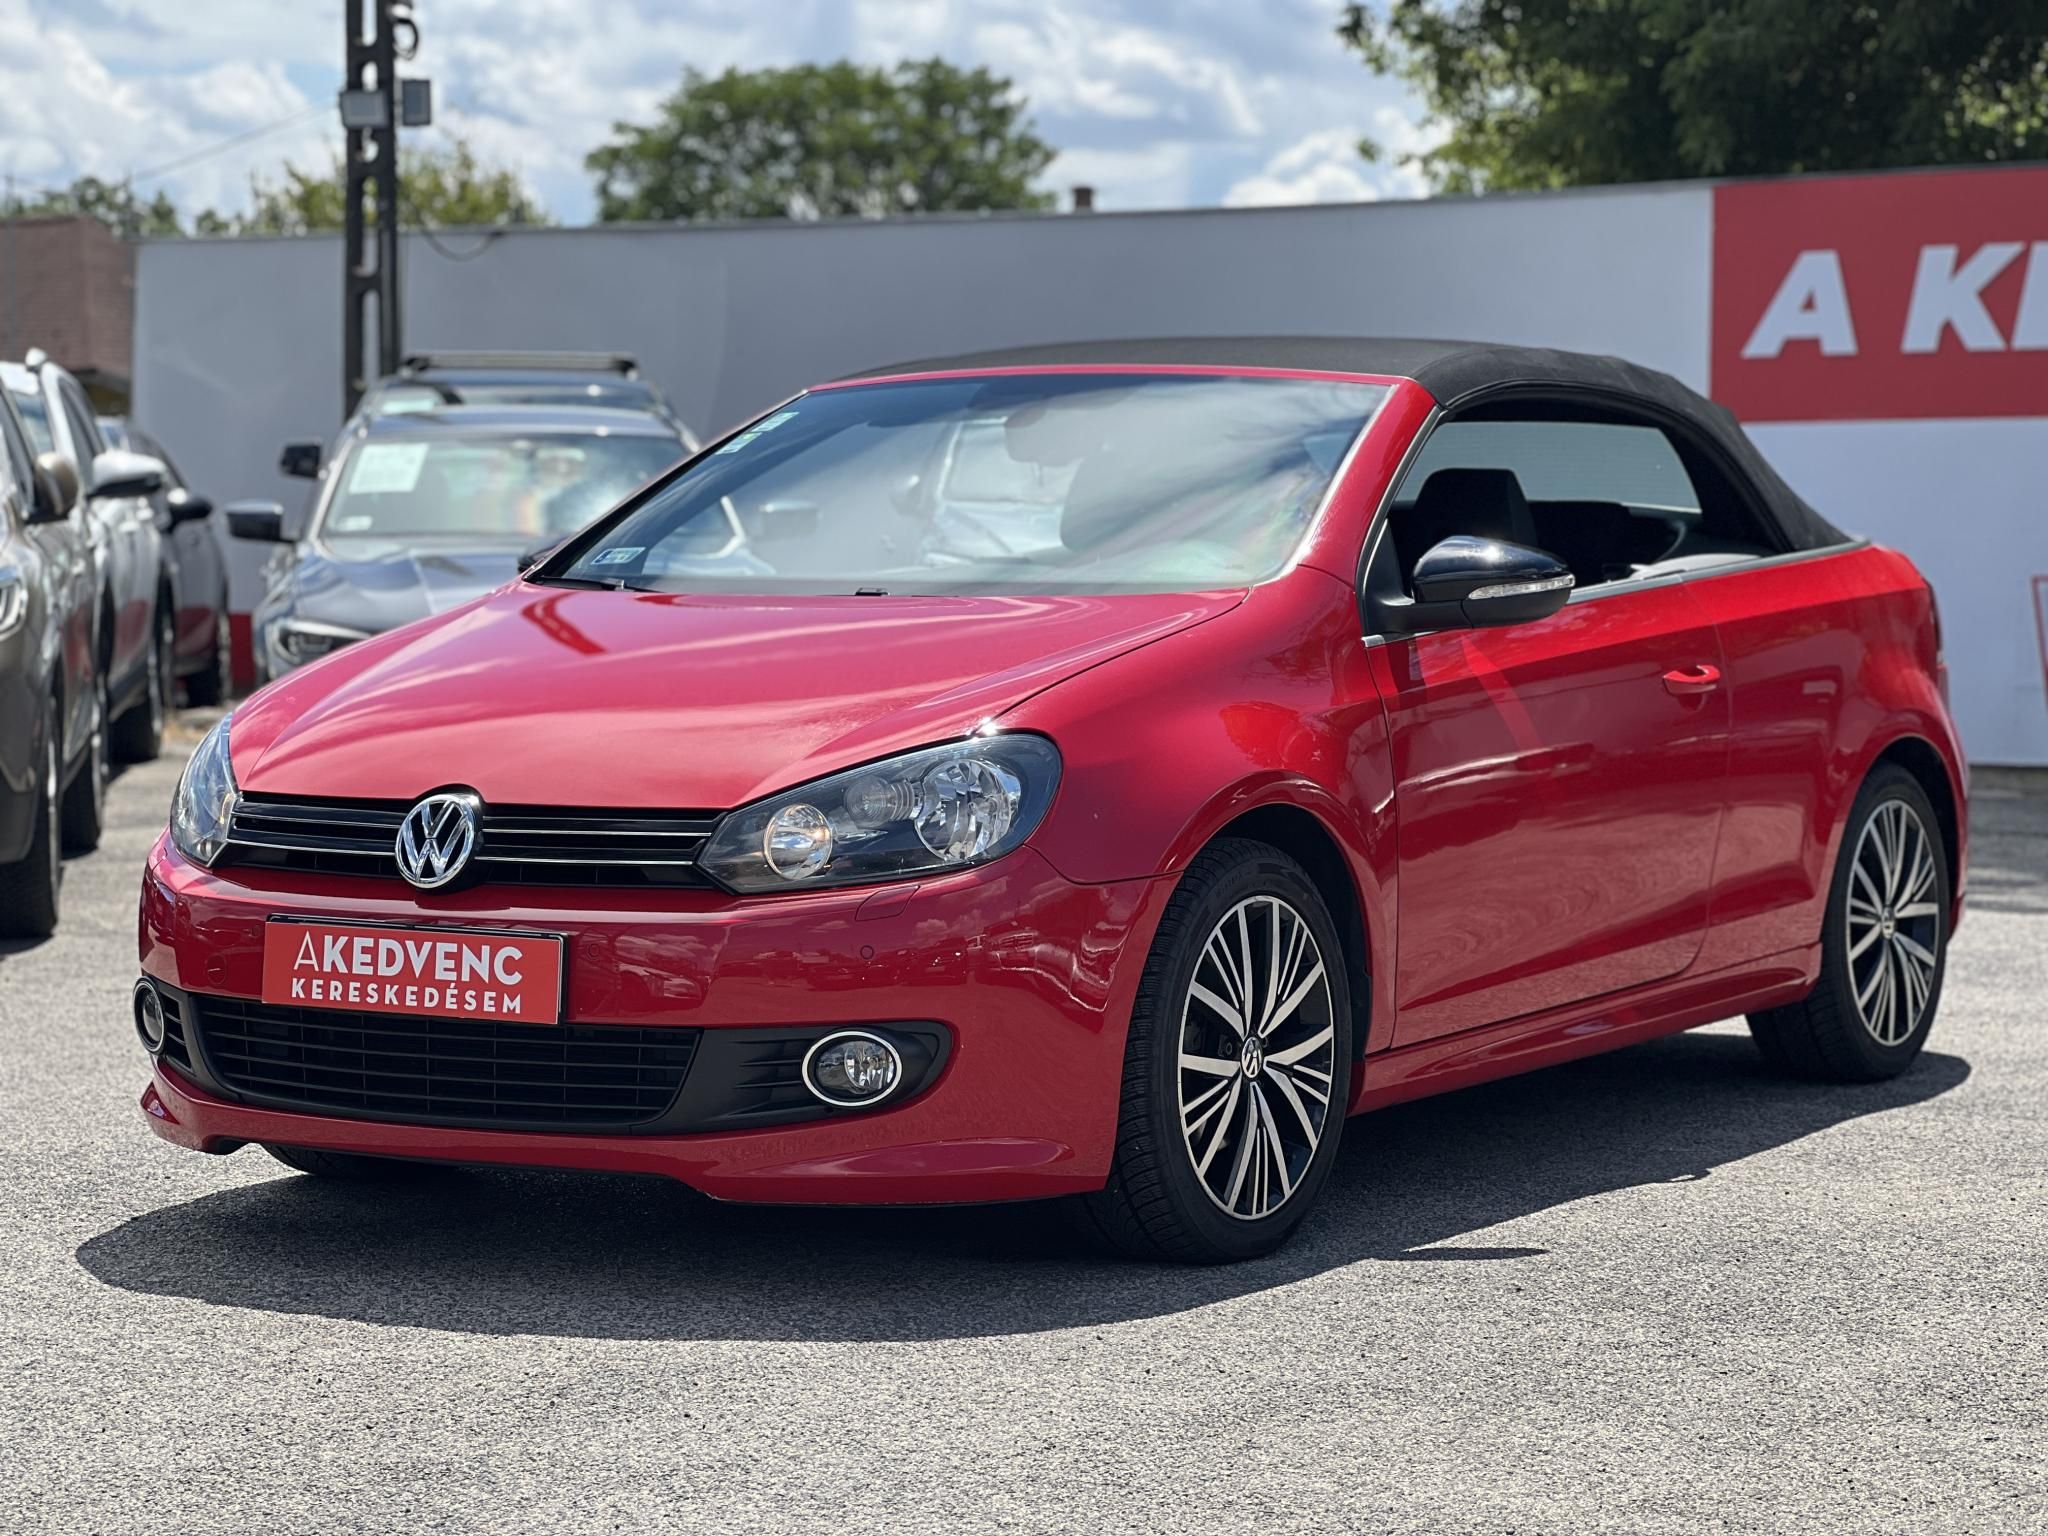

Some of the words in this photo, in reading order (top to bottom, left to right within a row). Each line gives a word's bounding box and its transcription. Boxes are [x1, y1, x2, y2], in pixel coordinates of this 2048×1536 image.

[1740, 249, 1859, 359] A
[397, 796, 472, 886] VW
[291, 977, 522, 1015] KERESKEDÉSEM
